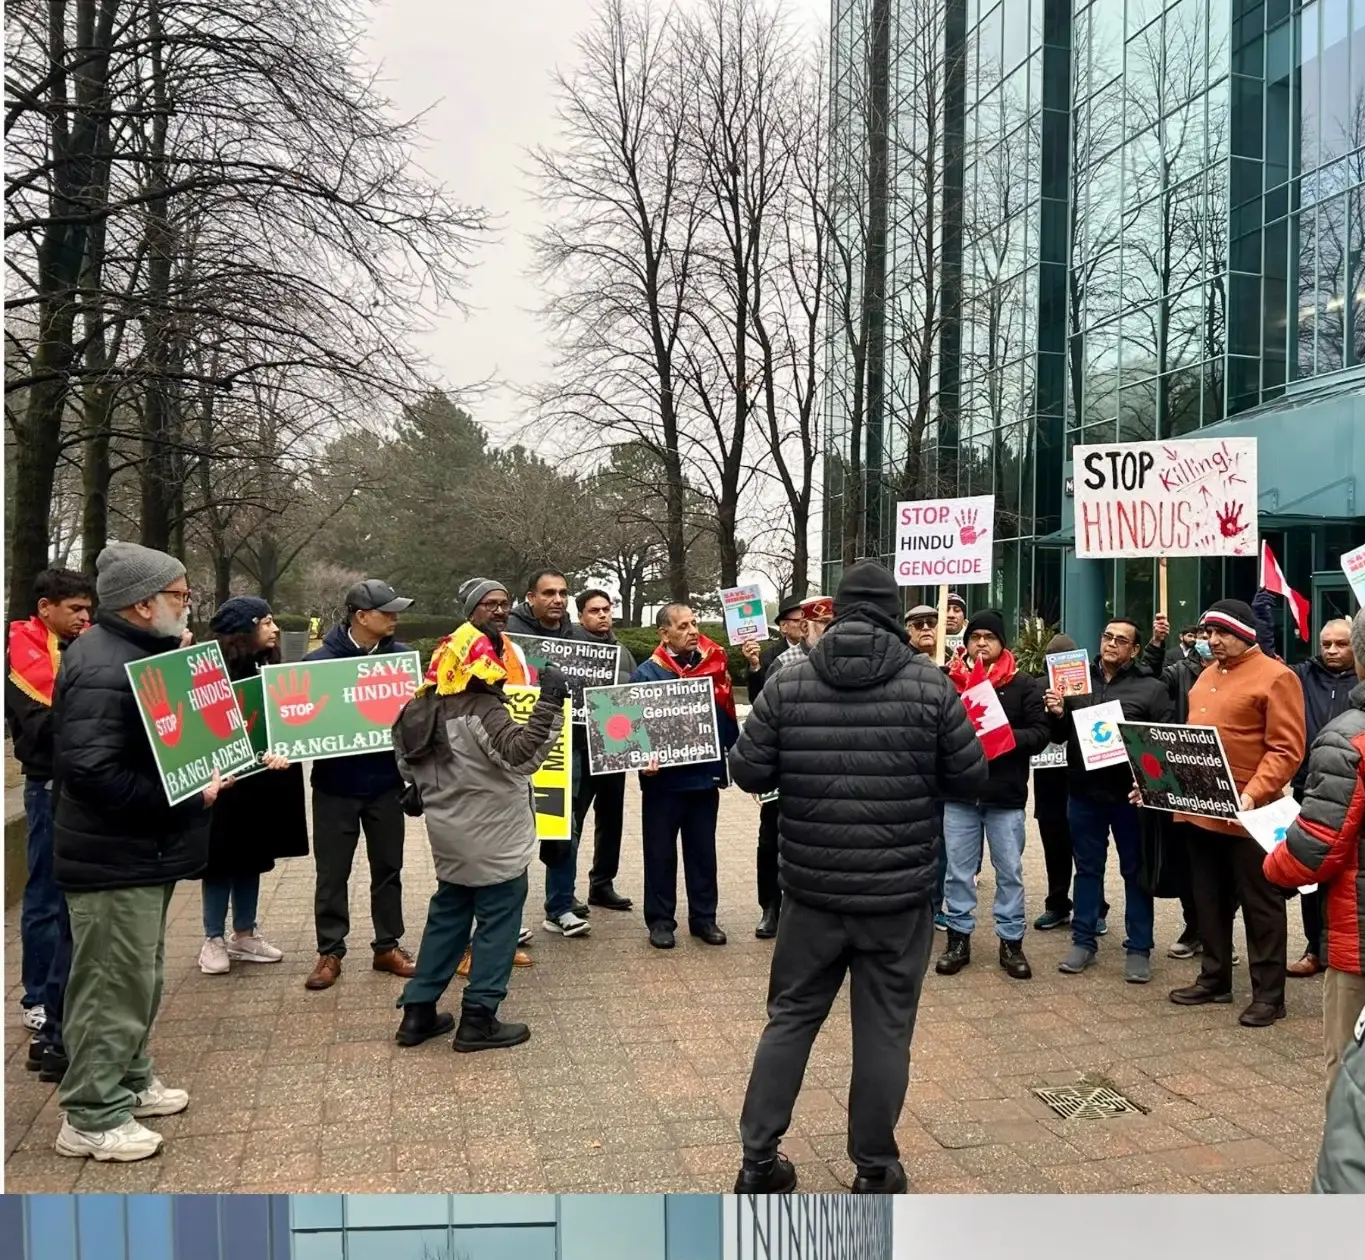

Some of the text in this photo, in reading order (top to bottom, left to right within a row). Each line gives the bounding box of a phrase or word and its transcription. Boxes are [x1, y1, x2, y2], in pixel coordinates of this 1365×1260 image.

[1084, 452, 1154, 491] STOP
[901, 507, 949, 525] STOP
[1083, 500, 1191, 552] HINDUS
[901, 535, 954, 551] HINDU
[900, 558, 982, 576] GENOCIDE
[541, 641, 615, 659] Stop Hindu
[187, 648, 221, 676] SAVE
[357, 657, 416, 678] SAVE
[188, 679, 232, 711] HINDUS
[343, 681, 417, 703] HINDUS
[630, 681, 708, 701] Stop Hindu
[226, 708, 240, 730] IN
[280, 703, 314, 718] STOP
[643, 702, 709, 719] Genocide
[156, 714, 177, 736] STOP
[698, 722, 711, 734] In
[275, 729, 392, 757] BANGLADE
[1150, 728, 1215, 745] Stop Hindu
[630, 742, 714, 764] Bangladesh
[1166, 751, 1222, 768] Genocide
[166, 738, 250, 794] BANGLADESH
[1217, 778, 1229, 790] In
[1167, 793, 1238, 813] Bangladesh
